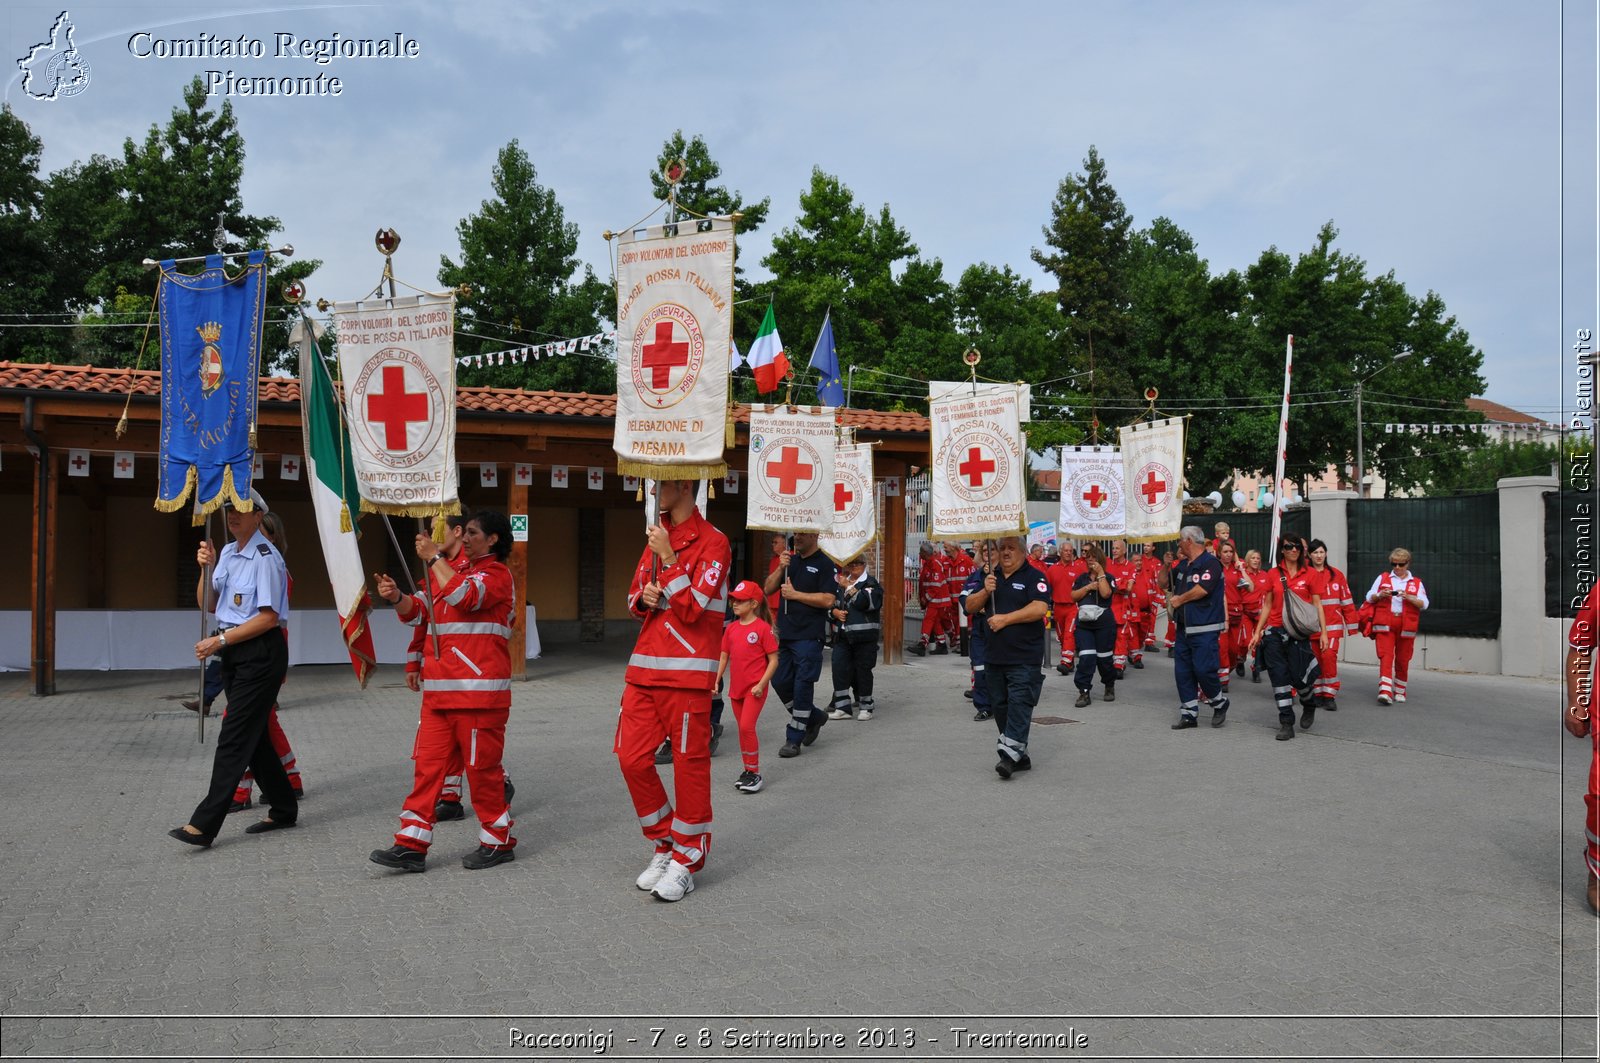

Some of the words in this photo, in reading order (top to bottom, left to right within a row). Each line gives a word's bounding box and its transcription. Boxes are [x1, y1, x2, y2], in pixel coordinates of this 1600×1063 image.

[640, 247, 675, 261] VOLONTARI
[676, 246, 688, 258] DEL
[691, 241, 727, 256] SOCCORSO
[620, 282, 643, 320] CROCE
[646, 268, 680, 286] ROSSA
[685, 271, 725, 313] ITALIANA
[361, 317, 392, 329] VOLONTRI
[398, 316, 412, 327] DEL
[415, 311, 447, 325] SCCORSO
[651, 306, 684, 321] GINEVRA
[644, 317, 652, 327] DI
[684, 315, 695, 328] 22
[374, 331, 406, 343] ROSSA
[399, 351, 409, 360] DI
[691, 327, 702, 371] AGOSTO
[680, 373, 695, 393] 1864
[627, 420, 687, 432] DELEGAZIONE
[692, 421, 704, 432] DI
[936, 434, 953, 465] CROCE
[953, 420, 984, 436] ROSSA
[987, 421, 1019, 457] ITALIANA
[964, 435, 994, 446] GINEVRA
[631, 441, 685, 455] PAESANA
[955, 443, 962, 452] DI
[949, 454, 971, 499] CONVENZIONE
[998, 456, 1008, 484] AGOSTO
[400, 471, 441, 483] LOCALE
[369, 487, 440, 500] RACCONIGI
[984, 483, 1000, 497] 1864
[760, 505, 787, 513] COMITATO
[940, 507, 976, 516] COMITATO
[978, 504, 1010, 513] LOCALE
[1012, 503, 1020, 511] DI
[764, 513, 813, 523] MORETTA
[935, 518, 964, 526] BORGO
[967, 517, 974, 525] S.
[977, 513, 1020, 523] DALMAZZ
[818, 530, 866, 540] SAVIGLIANO
